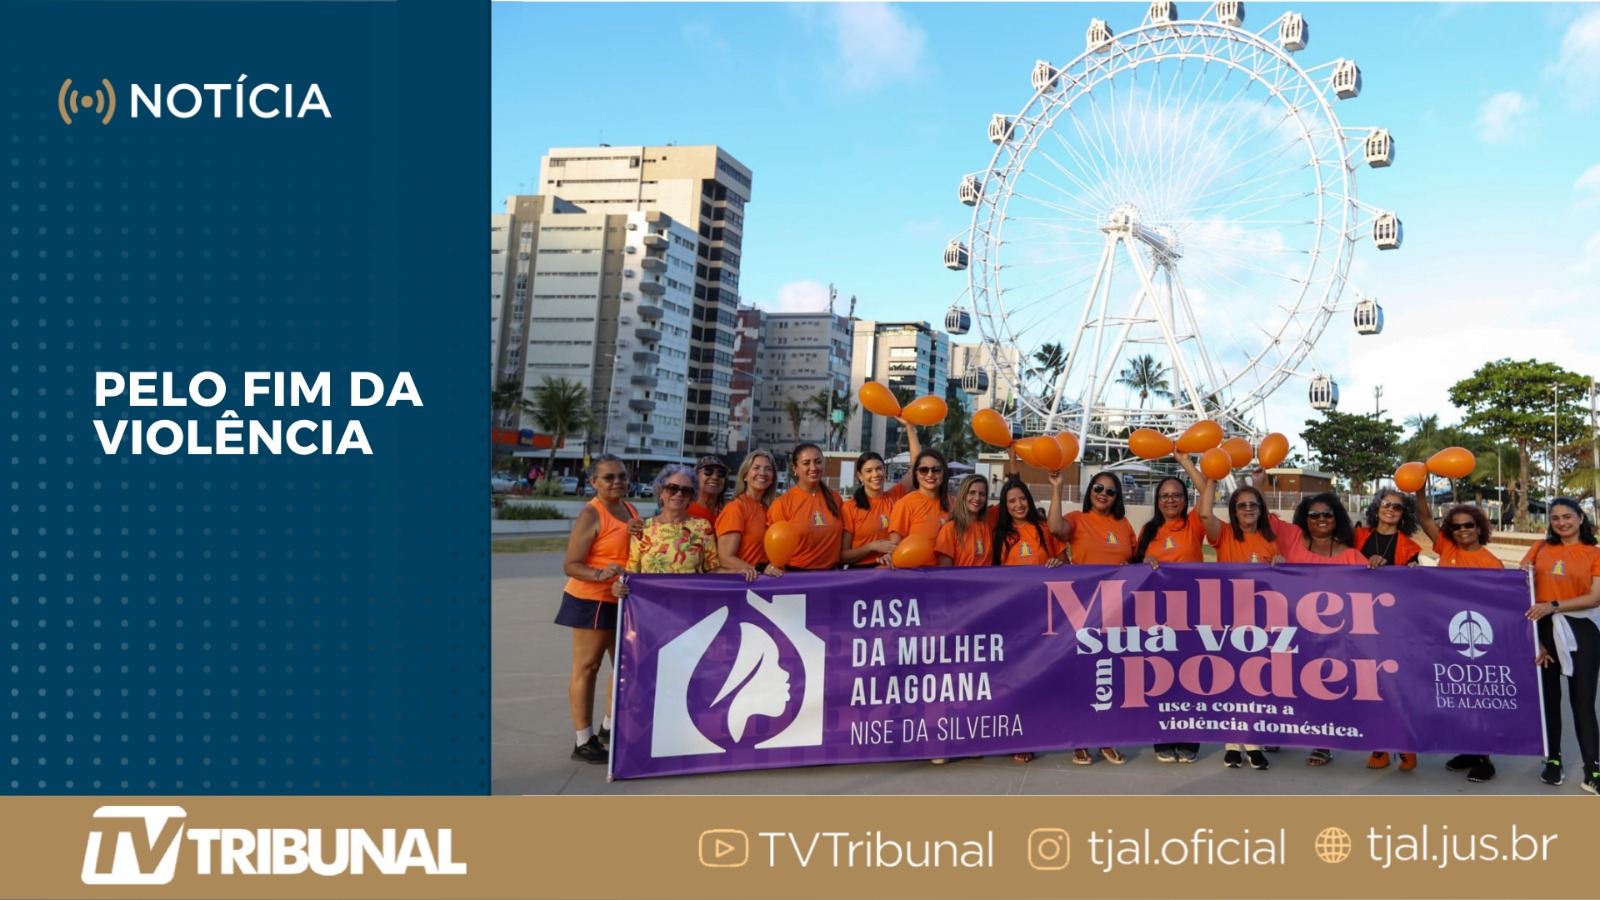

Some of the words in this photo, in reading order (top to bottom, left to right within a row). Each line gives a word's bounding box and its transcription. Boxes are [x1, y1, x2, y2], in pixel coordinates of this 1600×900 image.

[852, 598, 921, 629] CASA
[1041, 578, 1396, 635] Mulher
[852, 637, 886, 668] DA
[898, 633, 1005, 666] MULHER
[1075, 623, 1180, 656] sua
[1194, 623, 1300, 654] voz
[850, 671, 992, 707] ALAGOANA
[1090, 657, 1114, 713] tem
[1119, 645, 1400, 709] poder
[1433, 663, 1516, 685] PODER
[1212, 701, 1278, 715] contra
[1282, 704, 1295, 716] a
[1436, 696, 1456, 709] DE
[1457, 697, 1518, 710] ALAGOAS
[850, 719, 895, 746] NISE
[902, 718, 929, 743] DA
[937, 713, 1024, 742] SILVEIRA
[1158, 716, 1250, 732] violência
[1253, 719, 1365, 738] doméstica.
